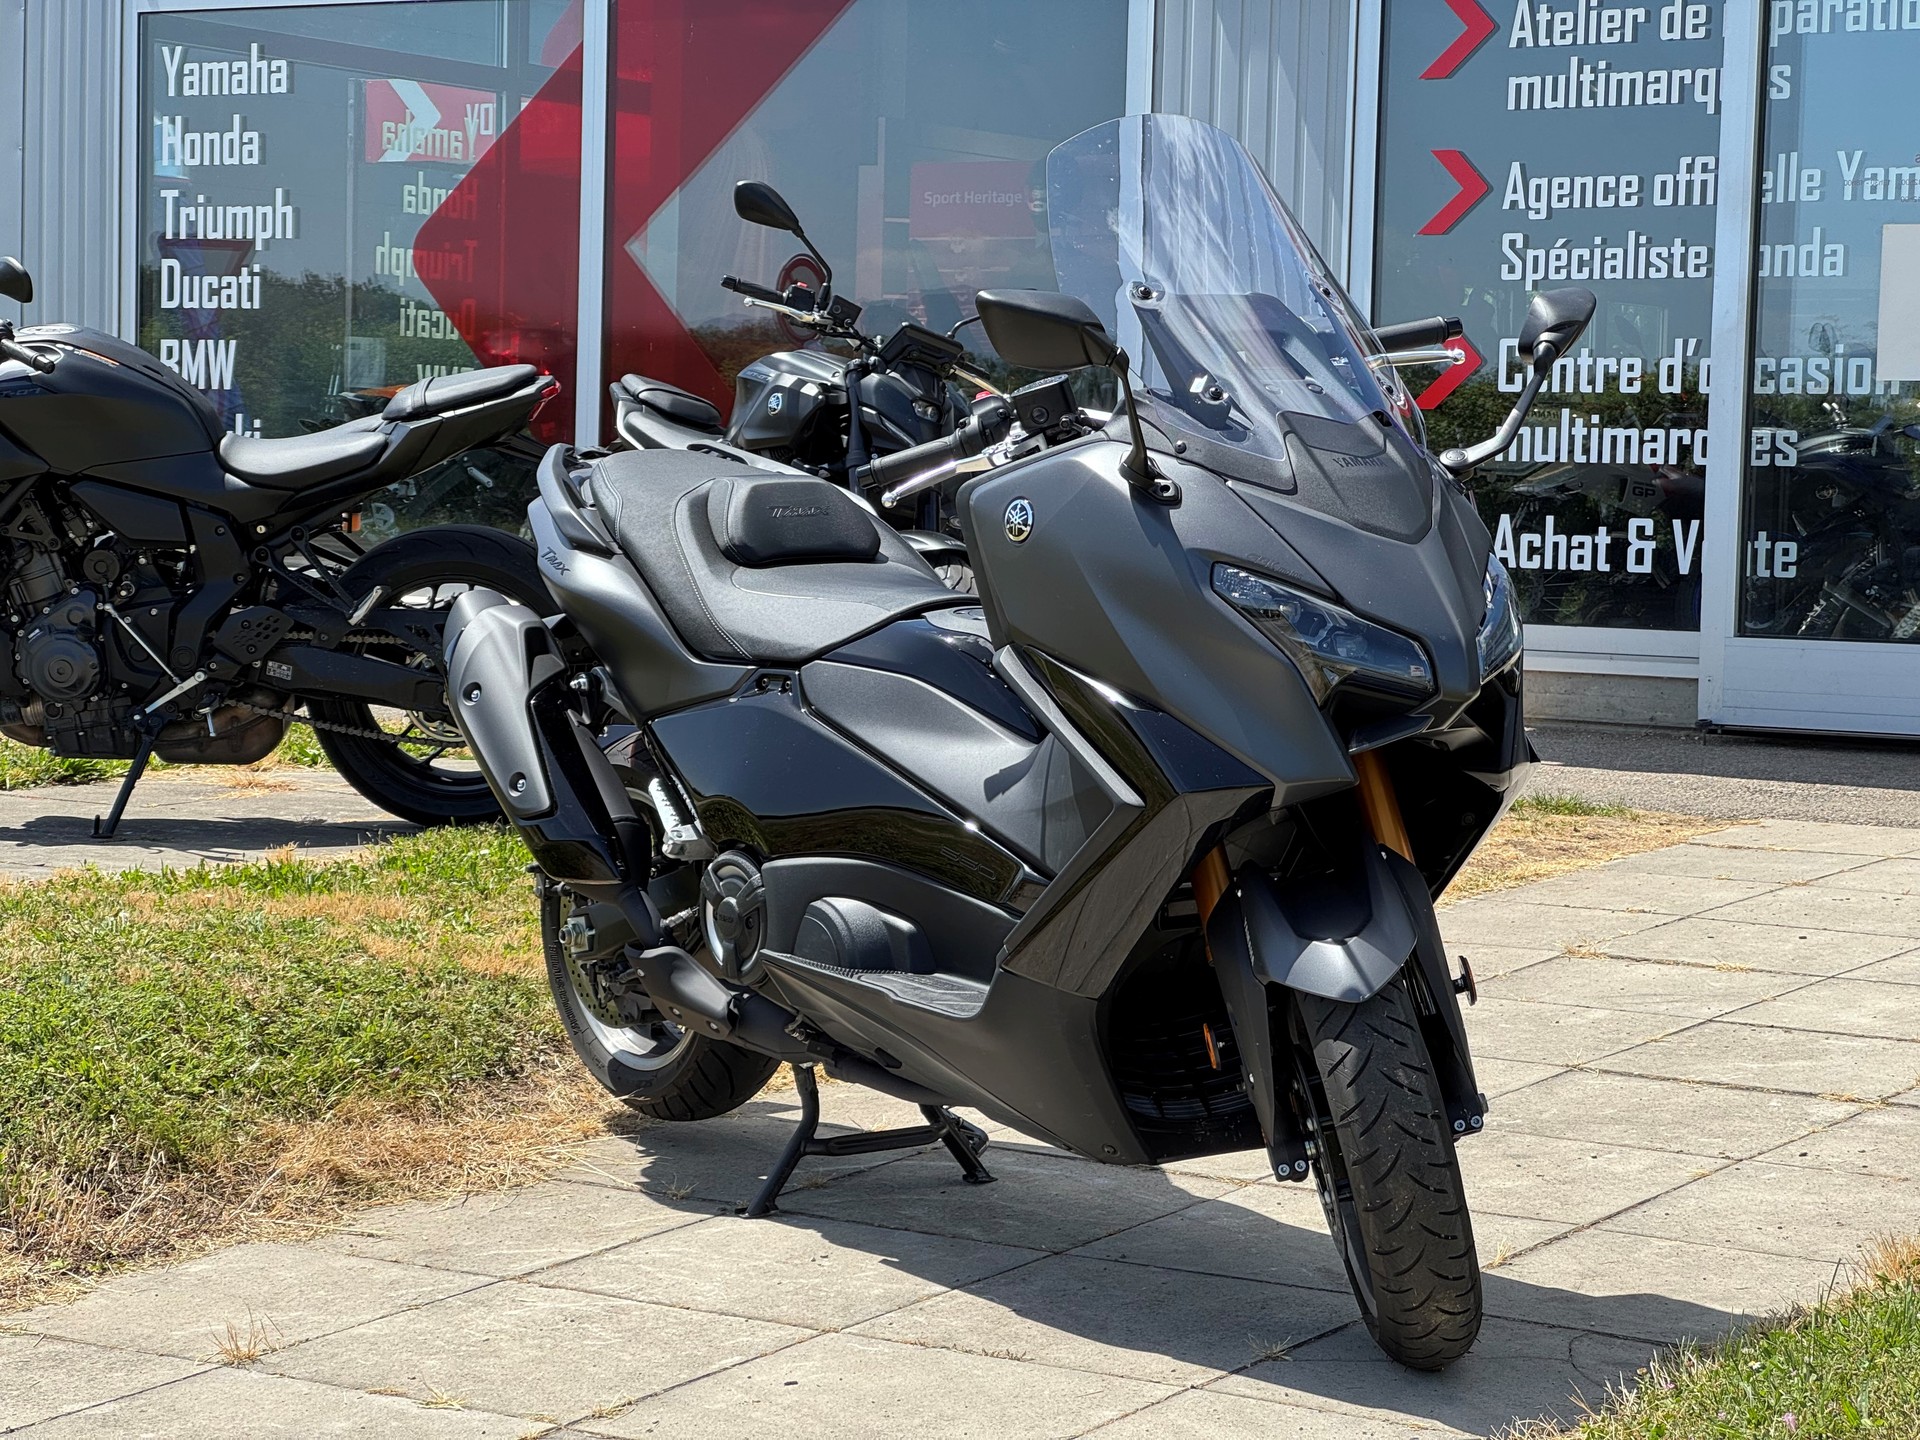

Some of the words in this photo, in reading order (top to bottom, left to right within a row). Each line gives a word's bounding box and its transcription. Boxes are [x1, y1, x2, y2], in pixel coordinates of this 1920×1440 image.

[1509, 0, 1646, 48] Atelier
[1659, 0, 1707, 42] de
[161, 43, 288, 96] Yamaha
[1507, 56, 1792, 115] multimarqs
[161, 114, 259, 166] Honda
[924, 191, 961, 207] Sport
[964, 190, 1022, 207] Heritage
[1502, 162, 1640, 220] Agence
[160, 188, 293, 251] Triumph
[160, 259, 261, 310] Ducati
[1501, 230, 1708, 291] Spécialiste
[1759, 226, 1844, 278] onda
[160, 339, 237, 390] BMW
[1632, 485, 1656, 498] GP
[1493, 514, 1611, 572] Achat
[1626, 518, 1657, 574] &
[1672, 518, 1798, 579] Vte
